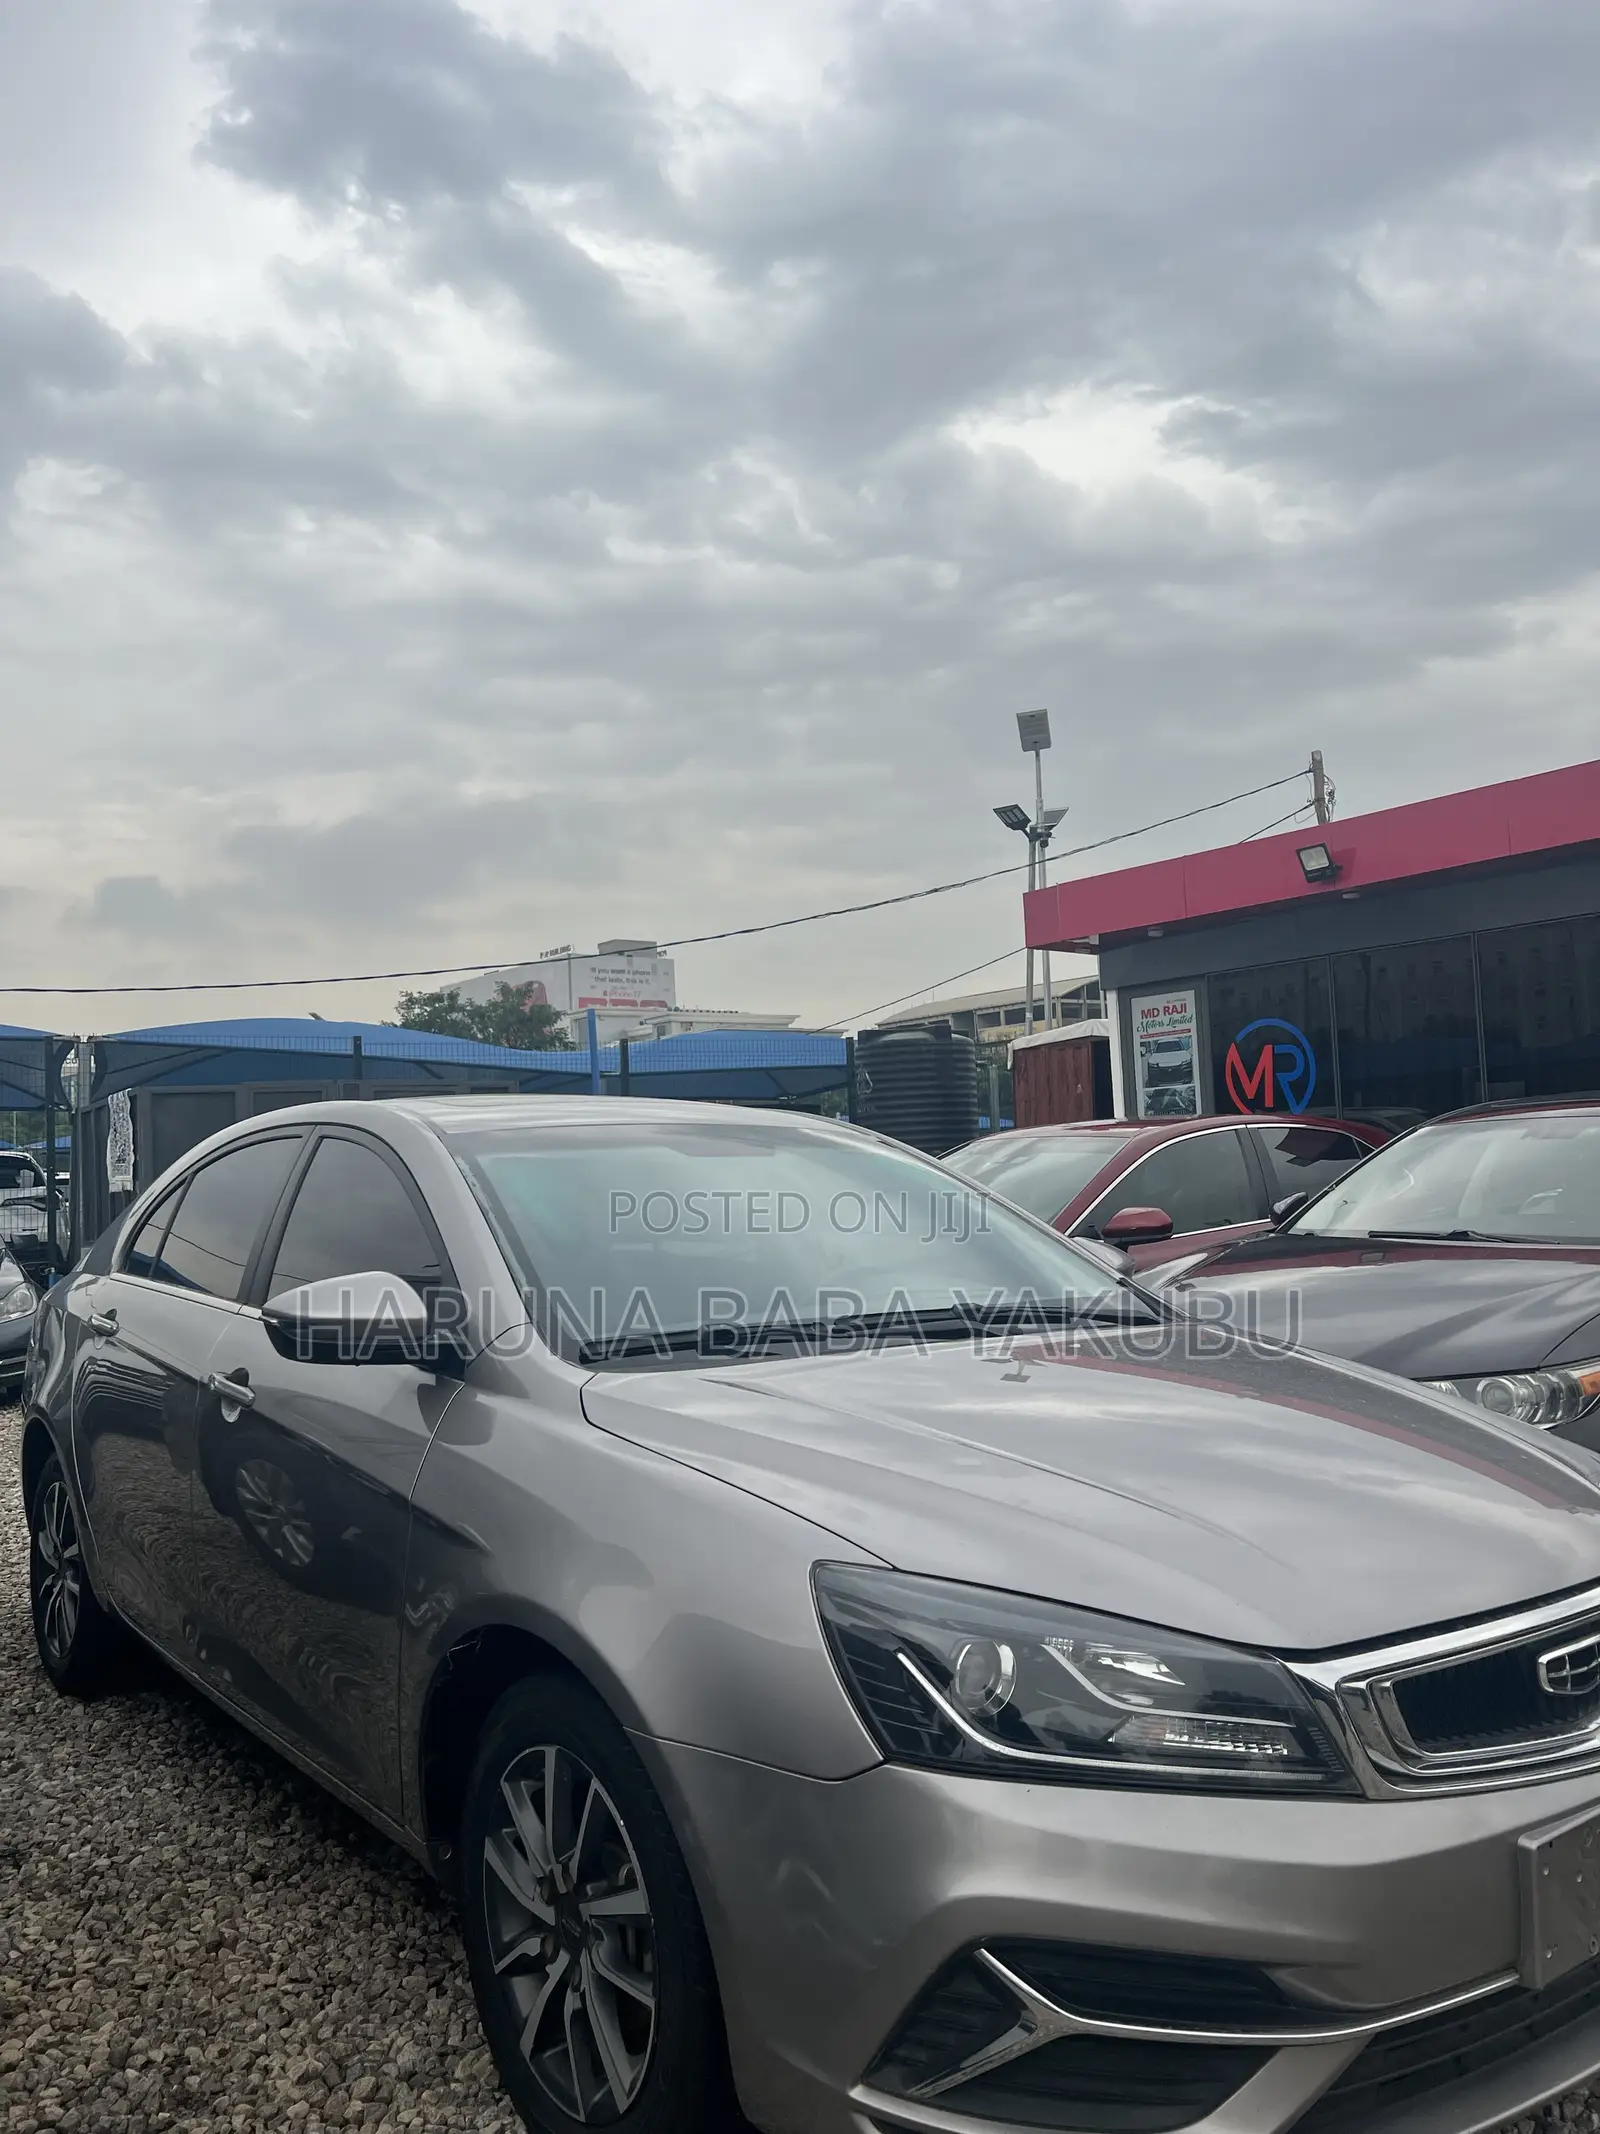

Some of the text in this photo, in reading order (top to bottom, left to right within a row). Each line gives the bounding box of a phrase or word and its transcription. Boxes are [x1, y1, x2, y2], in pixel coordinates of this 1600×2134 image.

[632, 968, 651, 976] phone
[1141, 1003, 1187, 1020] MD RAJI
[1137, 1020, 1165, 1035] Motors
[1166, 1014, 1193, 1029] Limited
